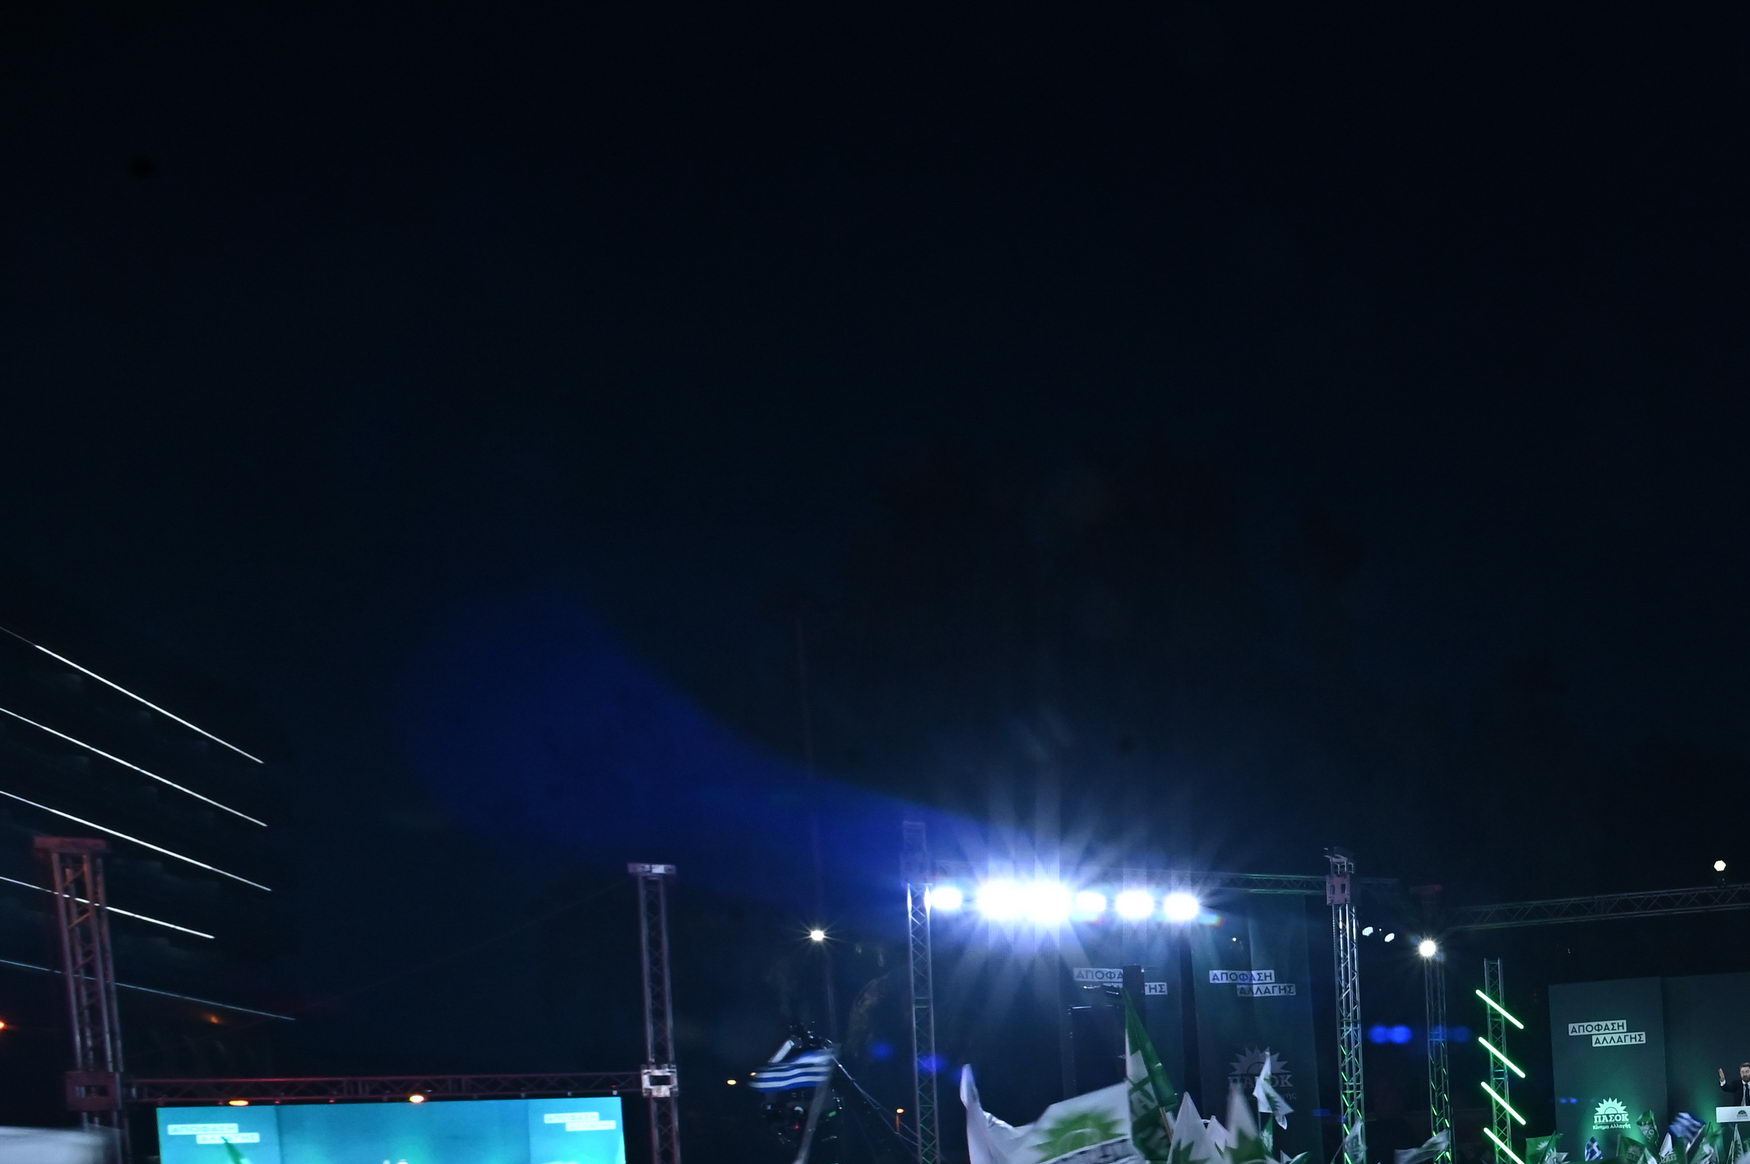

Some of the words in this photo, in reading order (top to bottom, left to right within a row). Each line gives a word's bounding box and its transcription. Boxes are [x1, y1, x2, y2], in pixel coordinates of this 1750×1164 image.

[1076, 971, 1124, 981] ΑΠΟΦΑ
[1212, 972, 1273, 982] ΑΠΟΦΑΣΗ
[1239, 985, 1294, 995] ΑΛΛΑΓΗΣ
[1570, 1021, 1625, 1034] ΑΠΟΦΑΣΗ
[1594, 1034, 1643, 1045] ΑΛΛΑΓΗΣ
[1594, 1114, 1629, 1123] ΠΑΣΟΚ
